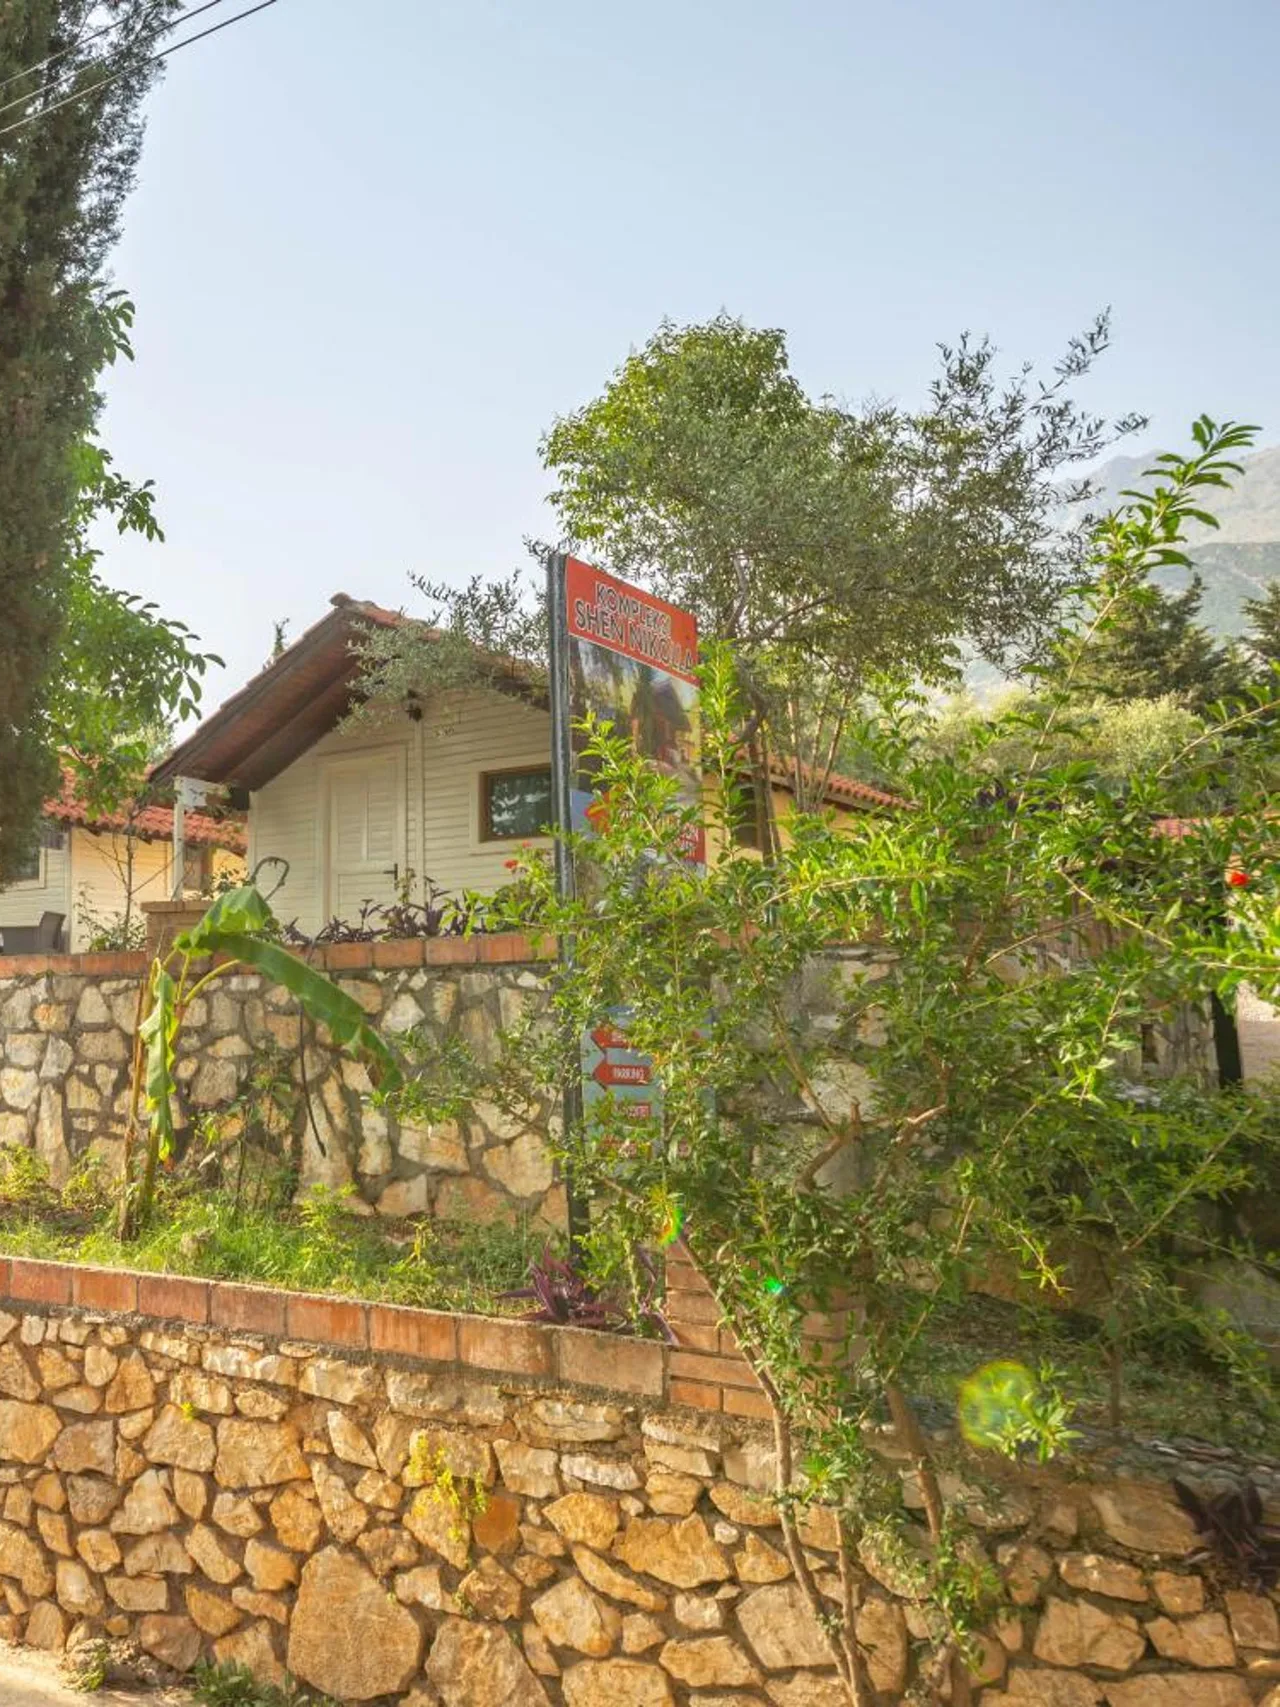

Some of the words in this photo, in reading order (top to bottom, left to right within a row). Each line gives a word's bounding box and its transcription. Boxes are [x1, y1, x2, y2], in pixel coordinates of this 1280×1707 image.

[575, 597, 625, 645] SHEN
[628, 620, 694, 675] NIKOLLA
[596, 581, 671, 632] KOMPLEKSI
